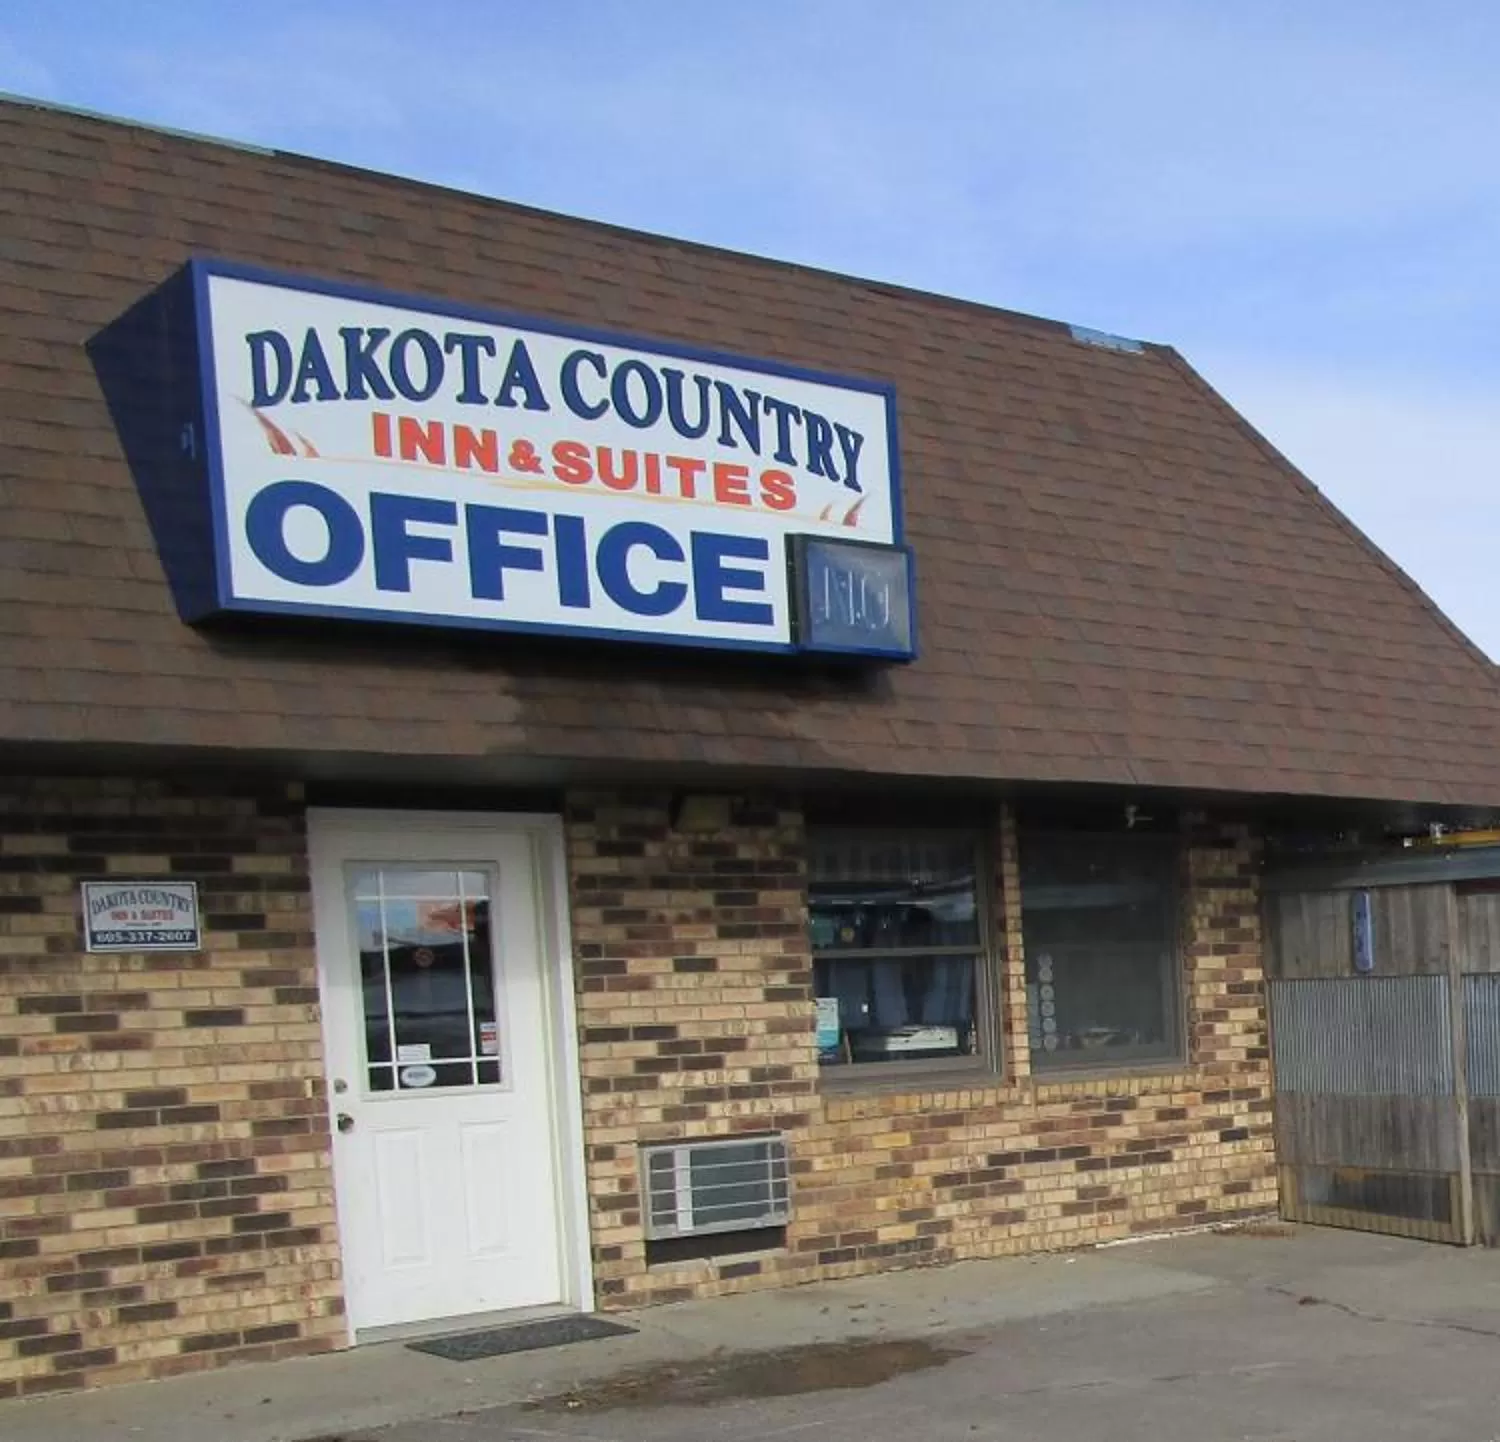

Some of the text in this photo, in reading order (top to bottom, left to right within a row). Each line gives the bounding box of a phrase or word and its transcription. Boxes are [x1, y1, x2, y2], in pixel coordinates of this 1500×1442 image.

[244, 326, 865, 494] DAKOTA COUNTRY
[244, 479, 775, 627] OFFICE
[91, 889, 192, 915] DAKOTA COUNTRY
